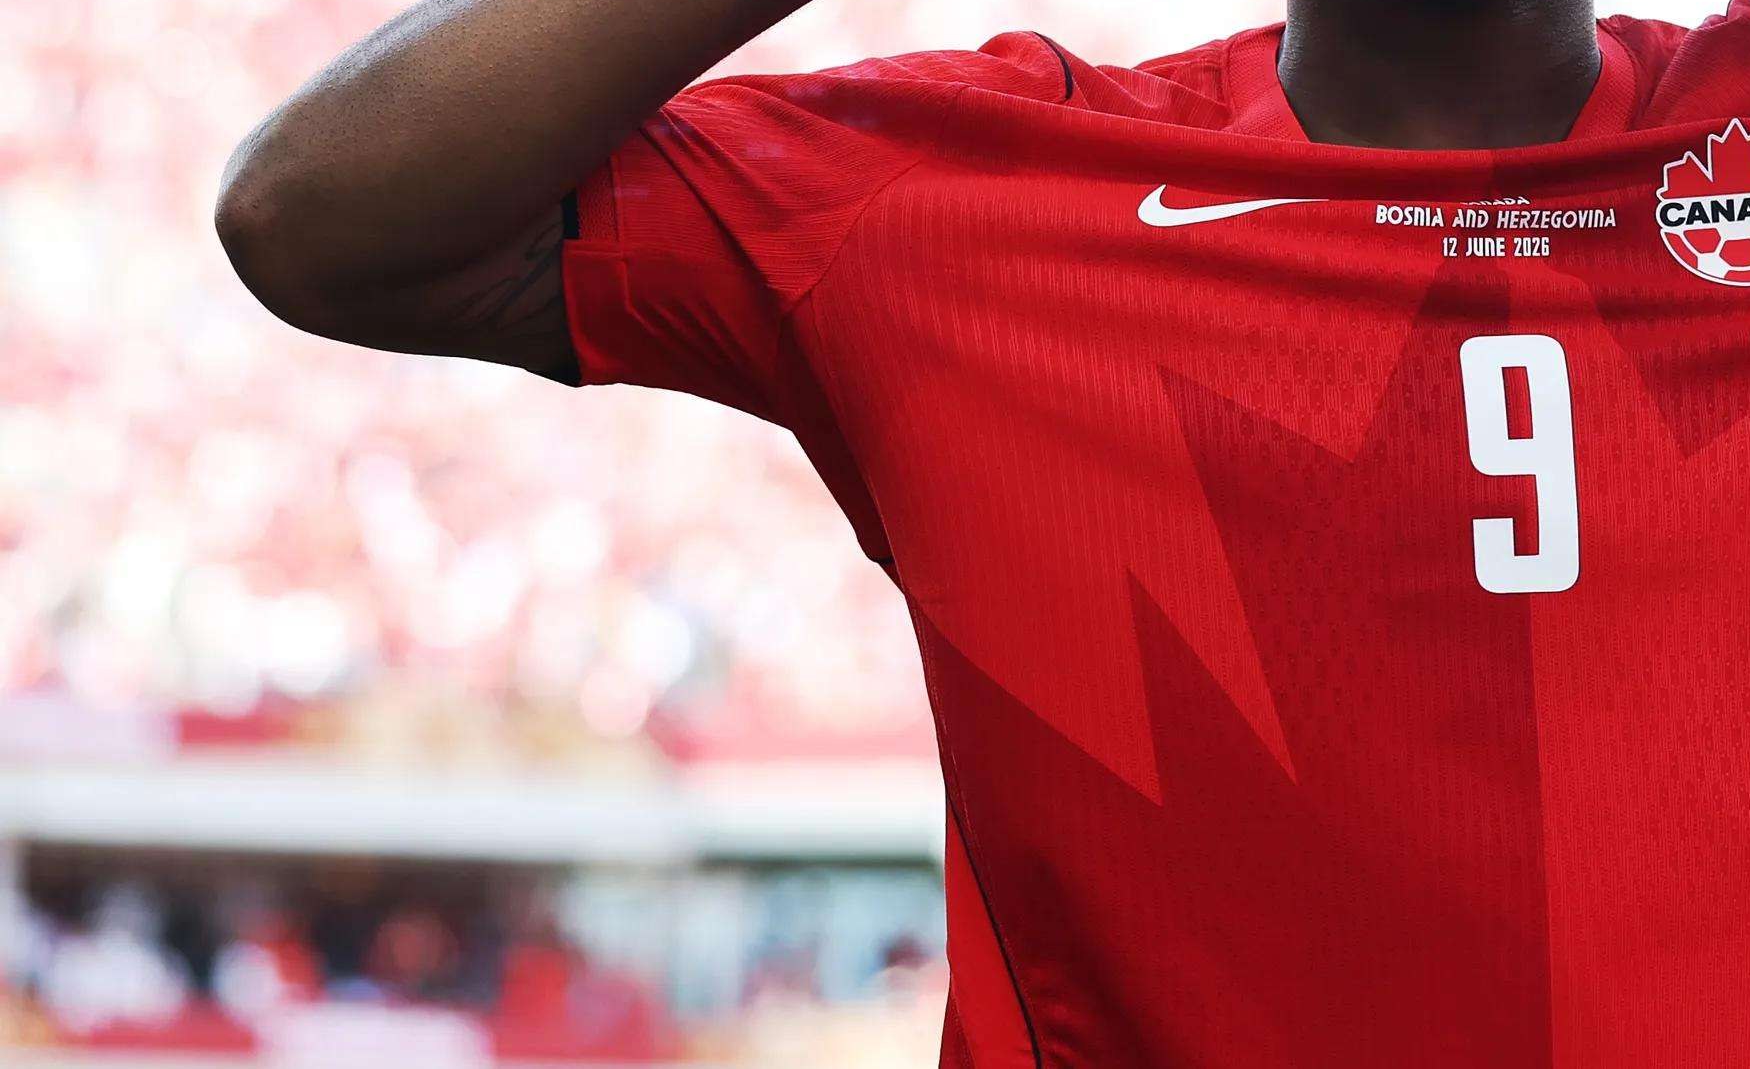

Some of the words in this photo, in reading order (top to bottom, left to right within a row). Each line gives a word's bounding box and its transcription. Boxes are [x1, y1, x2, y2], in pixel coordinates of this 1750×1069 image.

[1459, 196, 1530, 206] ADA
[1375, 204, 1444, 228] BOSNIA
[1452, 208, 1490, 228] AND
[1496, 208, 1617, 229] HERZEGOVINA
[1442, 237, 1458, 257] 12
[1465, 237, 1506, 257] JUNE
[1513, 236, 1550, 257] 2026
[1460, 335, 1580, 594] 9
